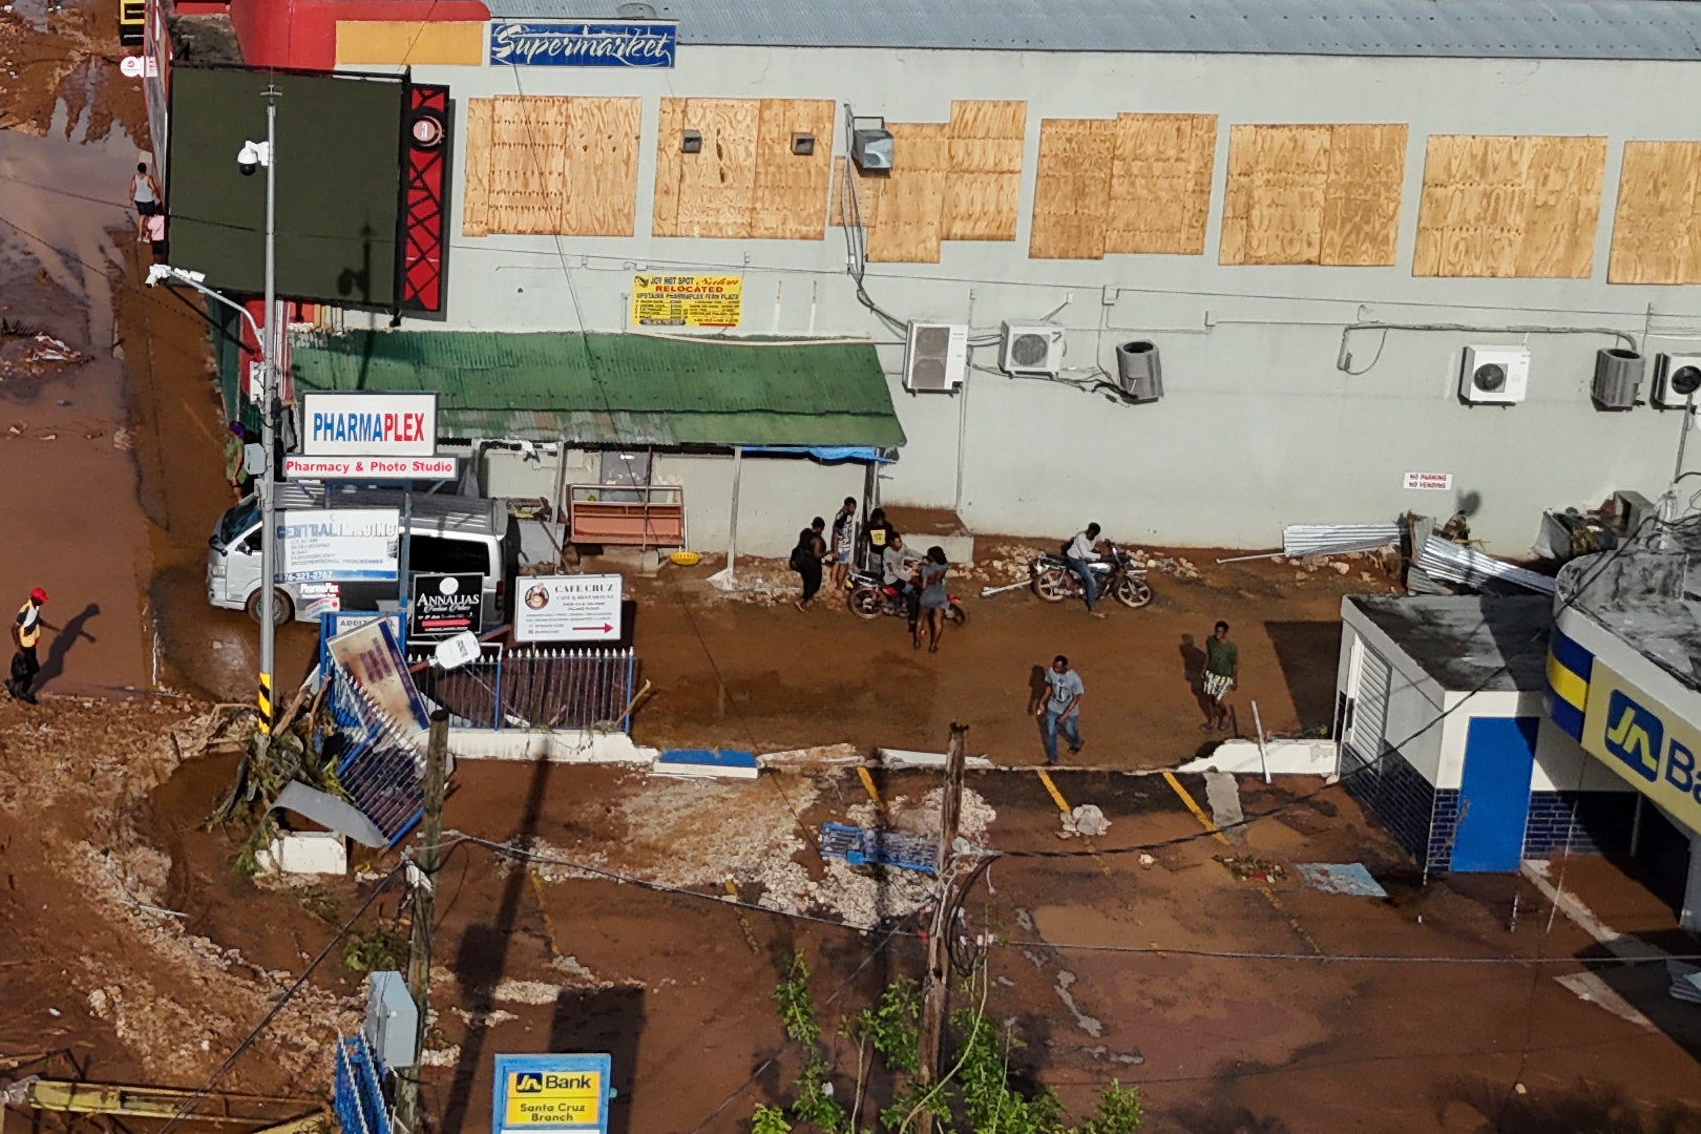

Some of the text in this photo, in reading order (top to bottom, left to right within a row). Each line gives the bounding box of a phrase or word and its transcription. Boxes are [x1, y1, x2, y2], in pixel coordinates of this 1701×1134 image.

[493, 24, 670, 66] Supermarket
[314, 413, 425, 442] PHARMAPLEX
[286, 461, 453, 474] Pharmacy & Photo Studio
[554, 584, 614, 593] CAFE CRUZ
[545, 1074, 592, 1089] Bank
[520, 1103, 586, 1113] Santa Cruz
[531, 1112, 574, 1122] Branch
